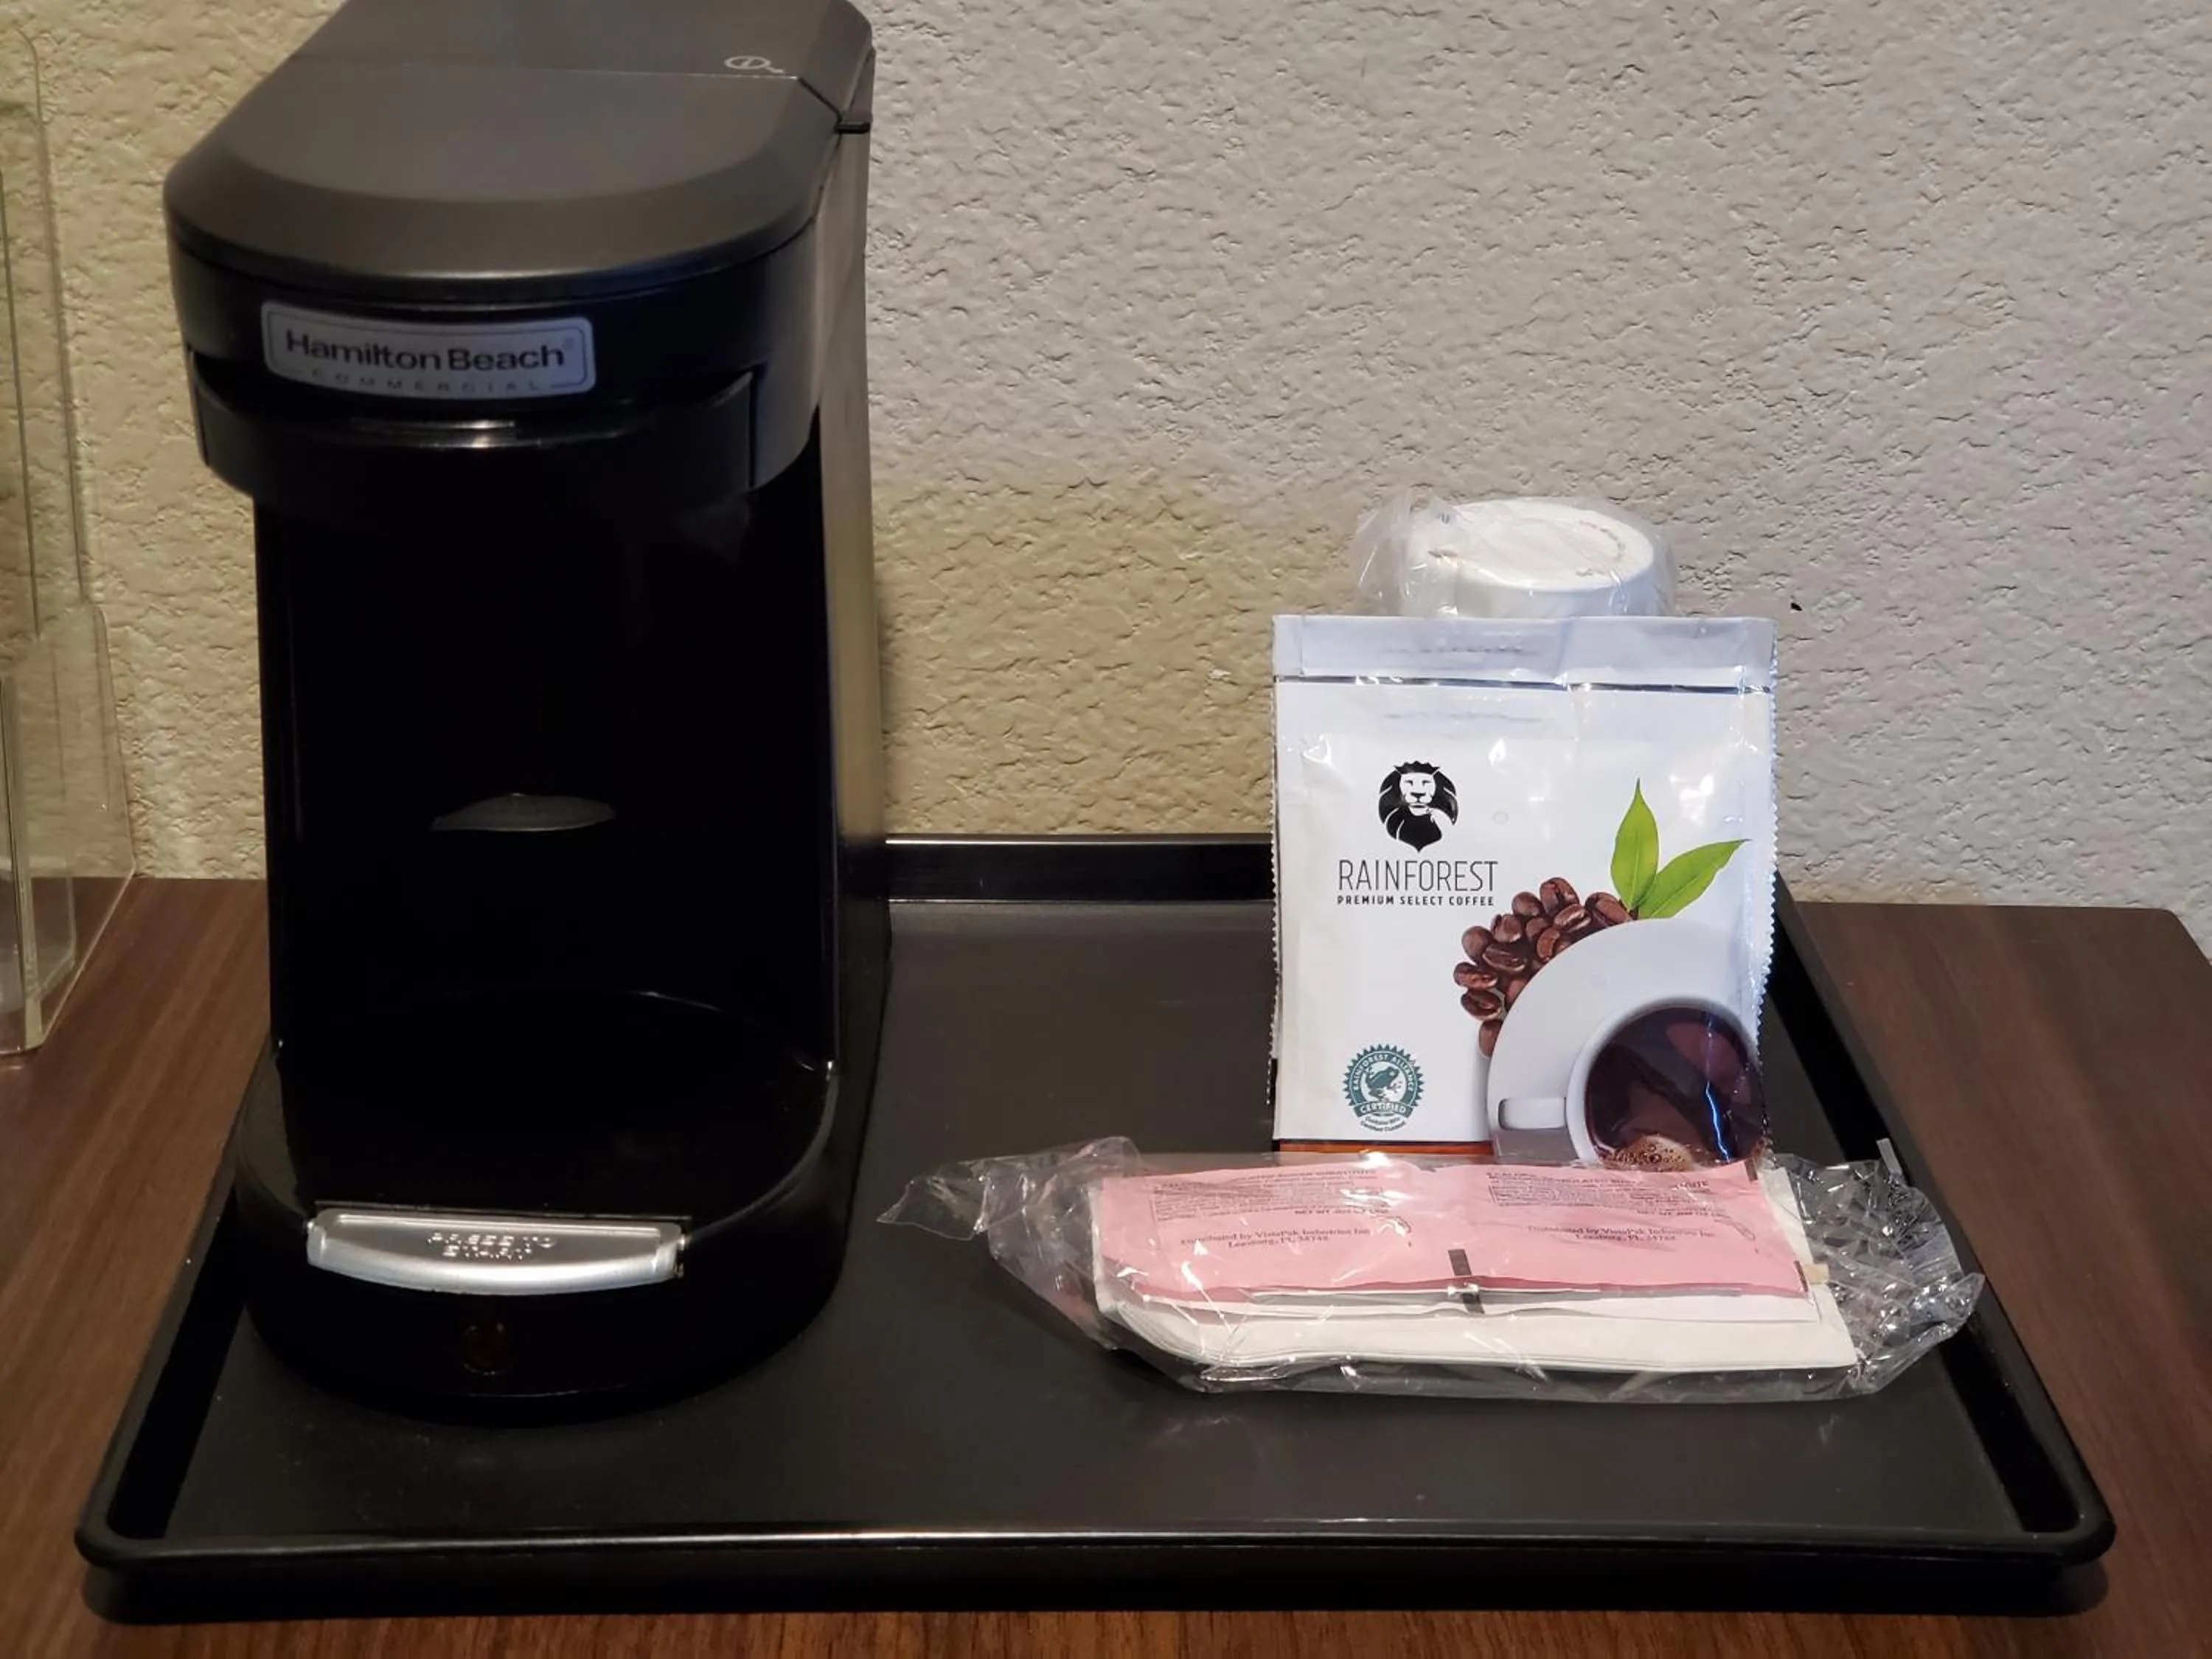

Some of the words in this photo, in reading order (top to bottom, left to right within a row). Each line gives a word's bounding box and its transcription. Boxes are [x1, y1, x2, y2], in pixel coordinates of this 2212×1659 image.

[286, 329, 442, 371] Hamilton
[448, 344, 565, 371] Beach
[1338, 859, 1498, 891] RAINFOREST
[1338, 895, 1394, 905] PREMIUM
[1400, 895, 1443, 906] SELECT
[1449, 896, 1494, 906] COFFEE
[1360, 1102, 1407, 1113] CERTIFIED
